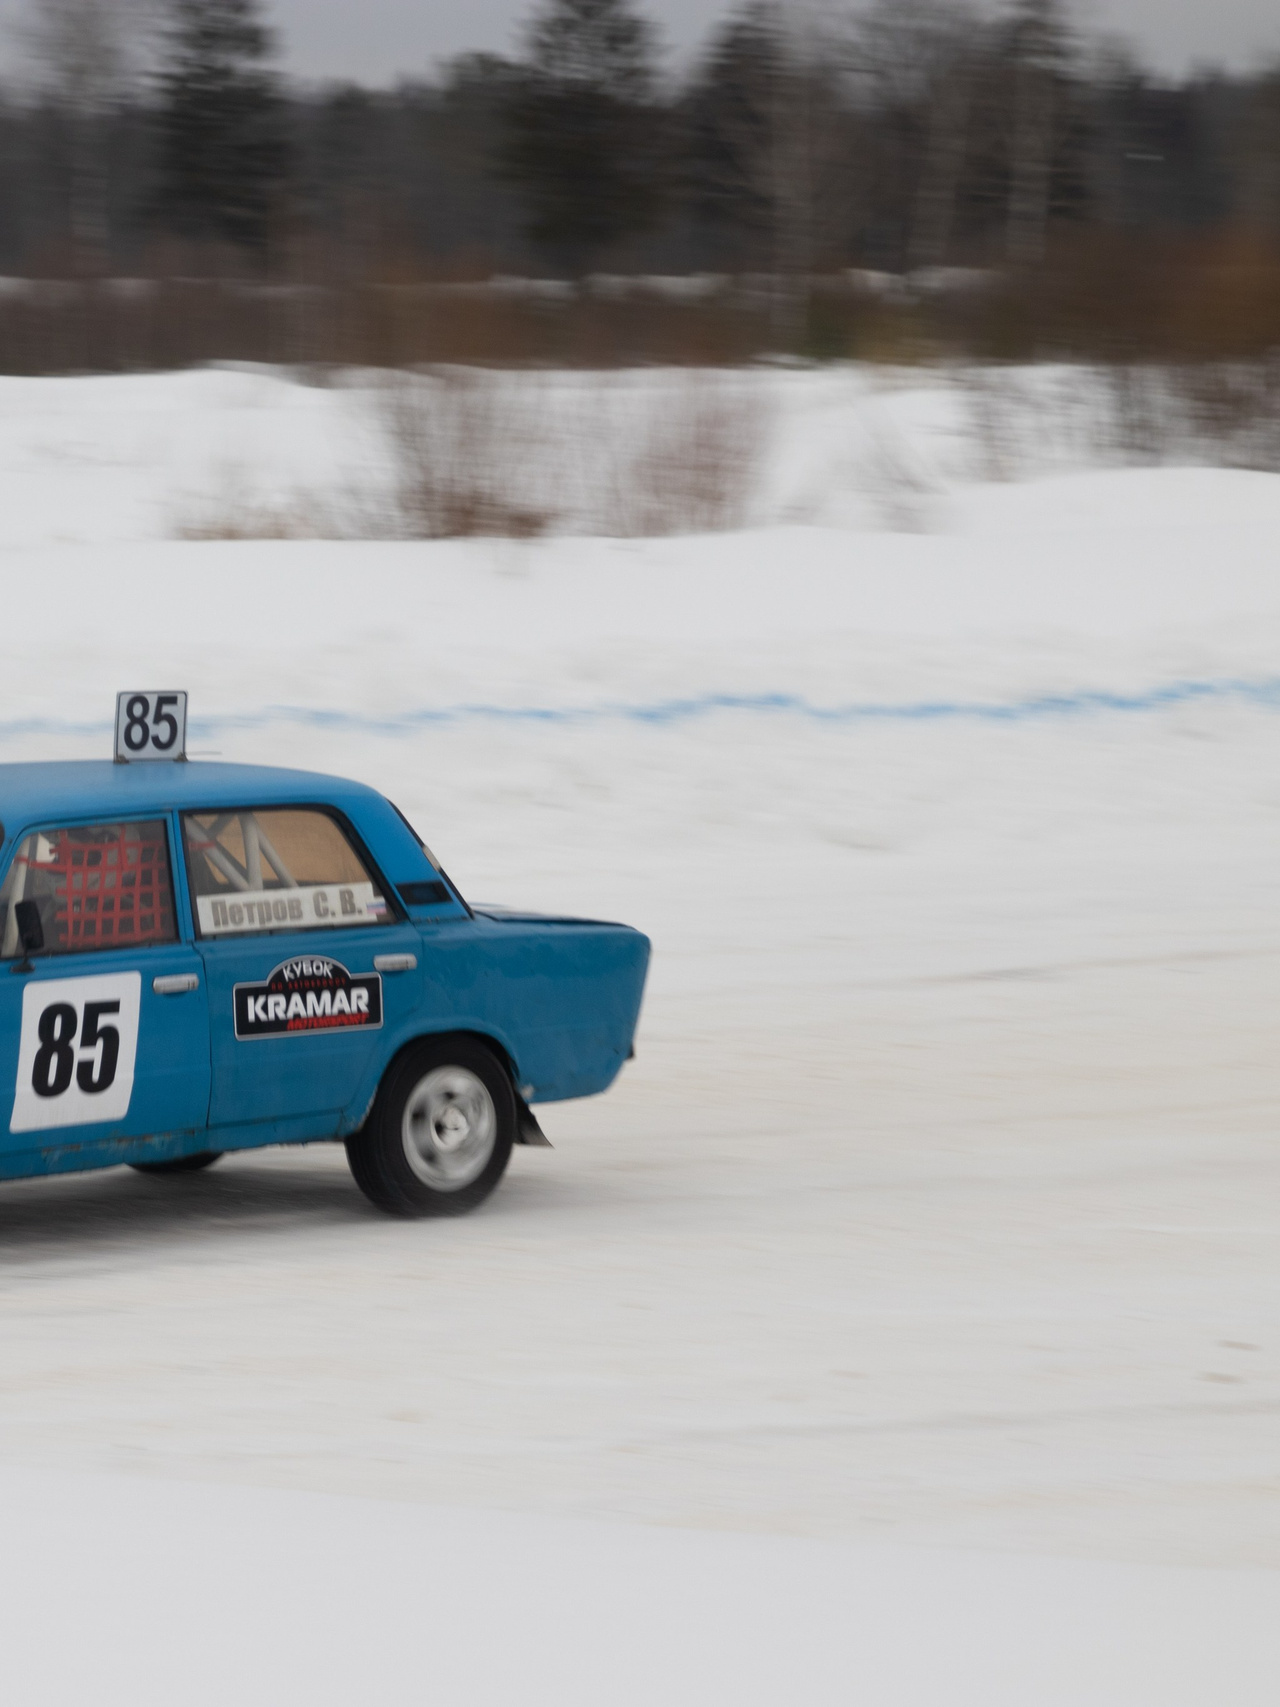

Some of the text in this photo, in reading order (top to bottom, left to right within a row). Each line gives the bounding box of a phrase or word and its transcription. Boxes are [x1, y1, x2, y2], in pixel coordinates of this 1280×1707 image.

[123, 695, 178, 751] 85
[211, 888, 363, 928] Петров С. В.
[282, 959, 334, 982] КУБОК
[247, 986, 370, 1023] KRAMAR
[31, 999, 121, 1098] 85
